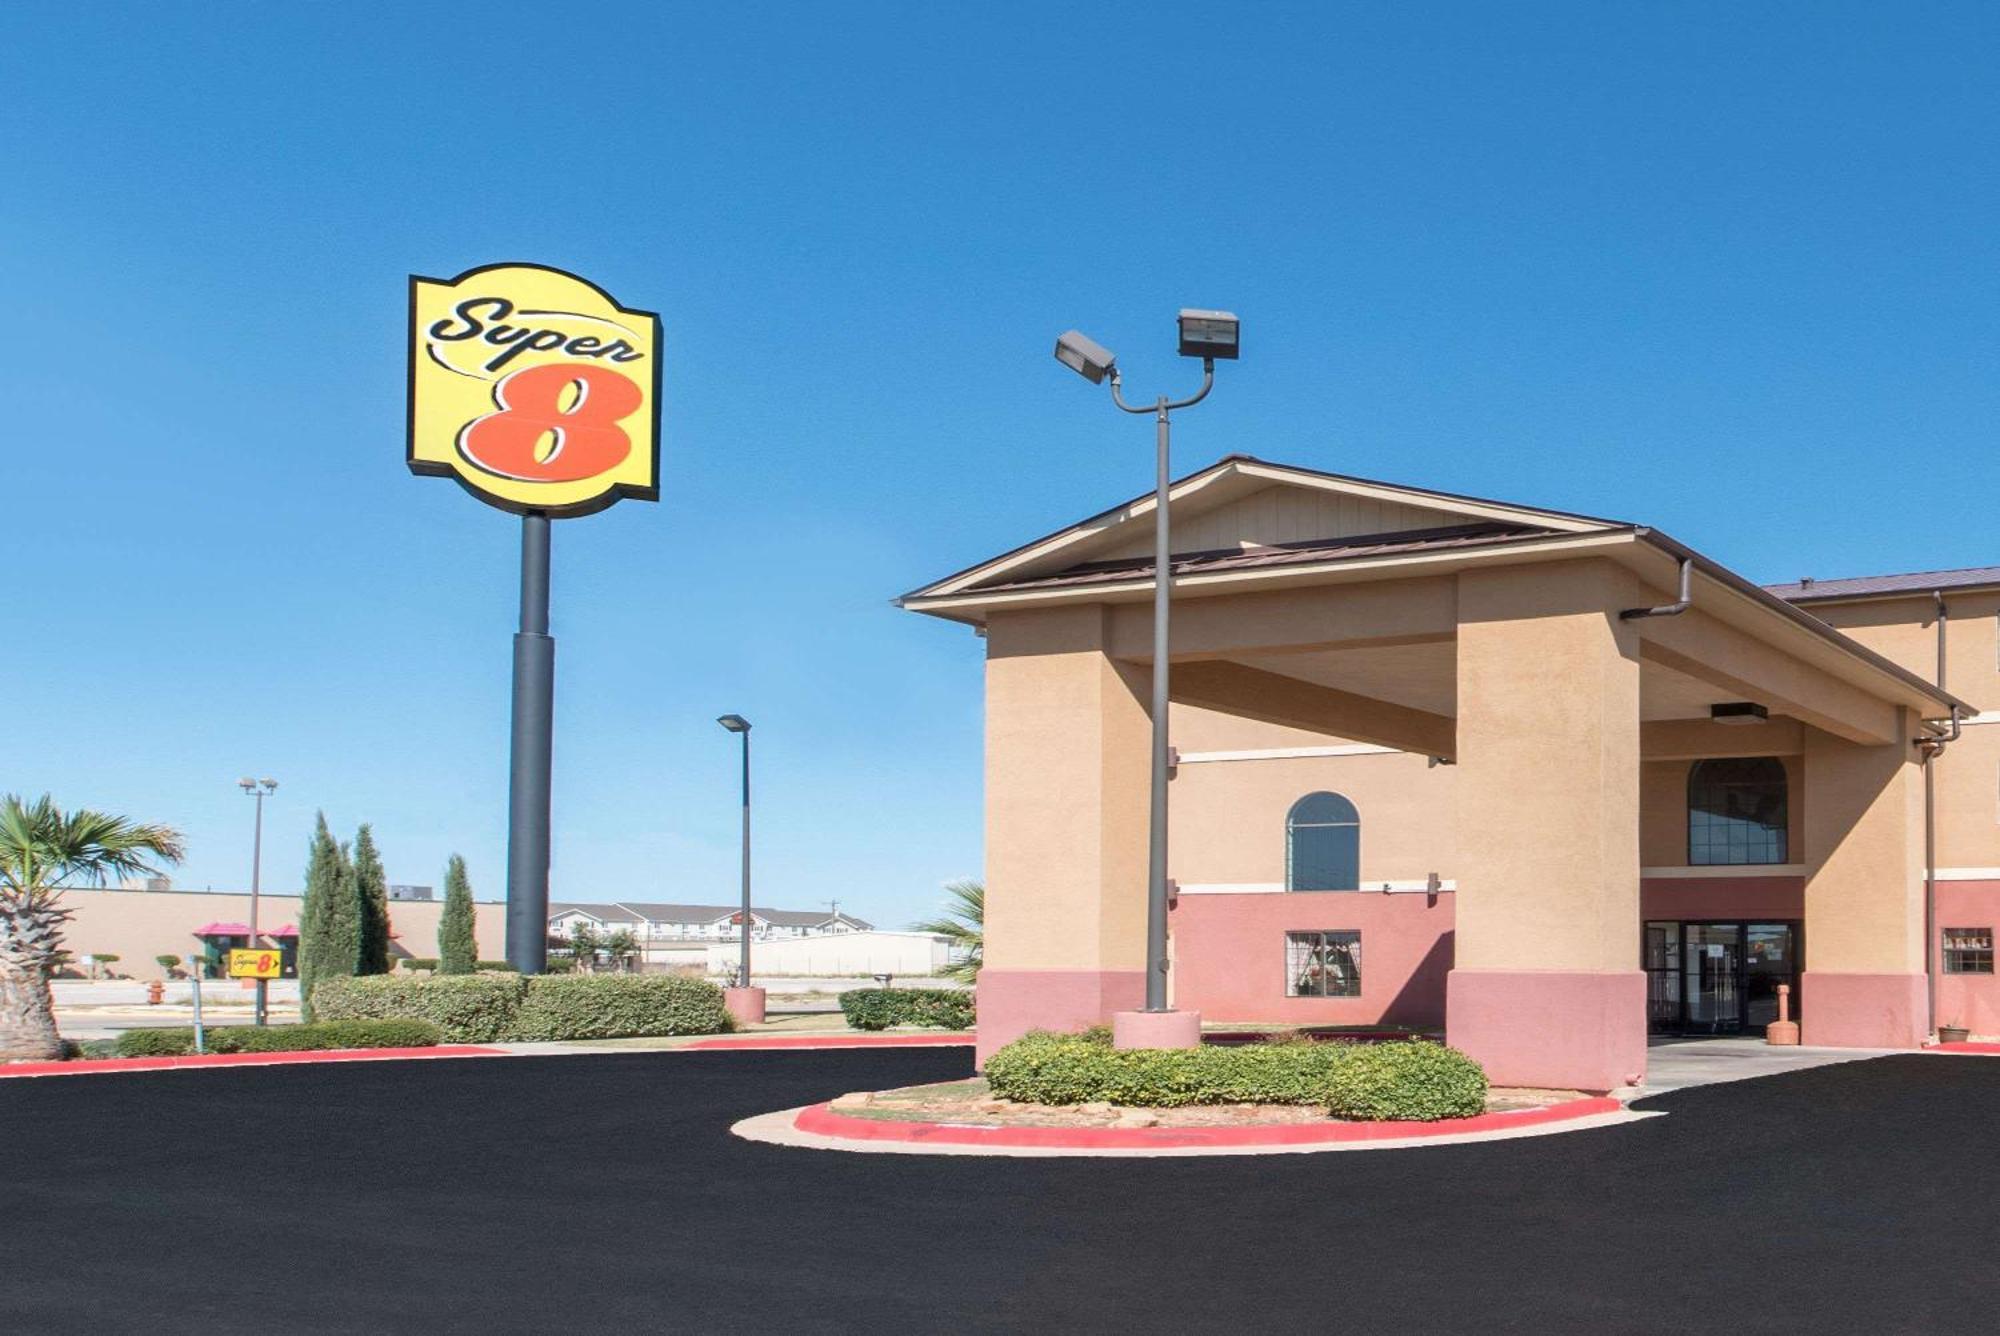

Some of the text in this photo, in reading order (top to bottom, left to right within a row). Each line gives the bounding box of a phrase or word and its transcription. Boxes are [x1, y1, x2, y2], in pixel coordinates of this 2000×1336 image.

[429, 297, 645, 373] Super
[455, 363, 643, 483] 8
[256, 954, 272, 973] 8
